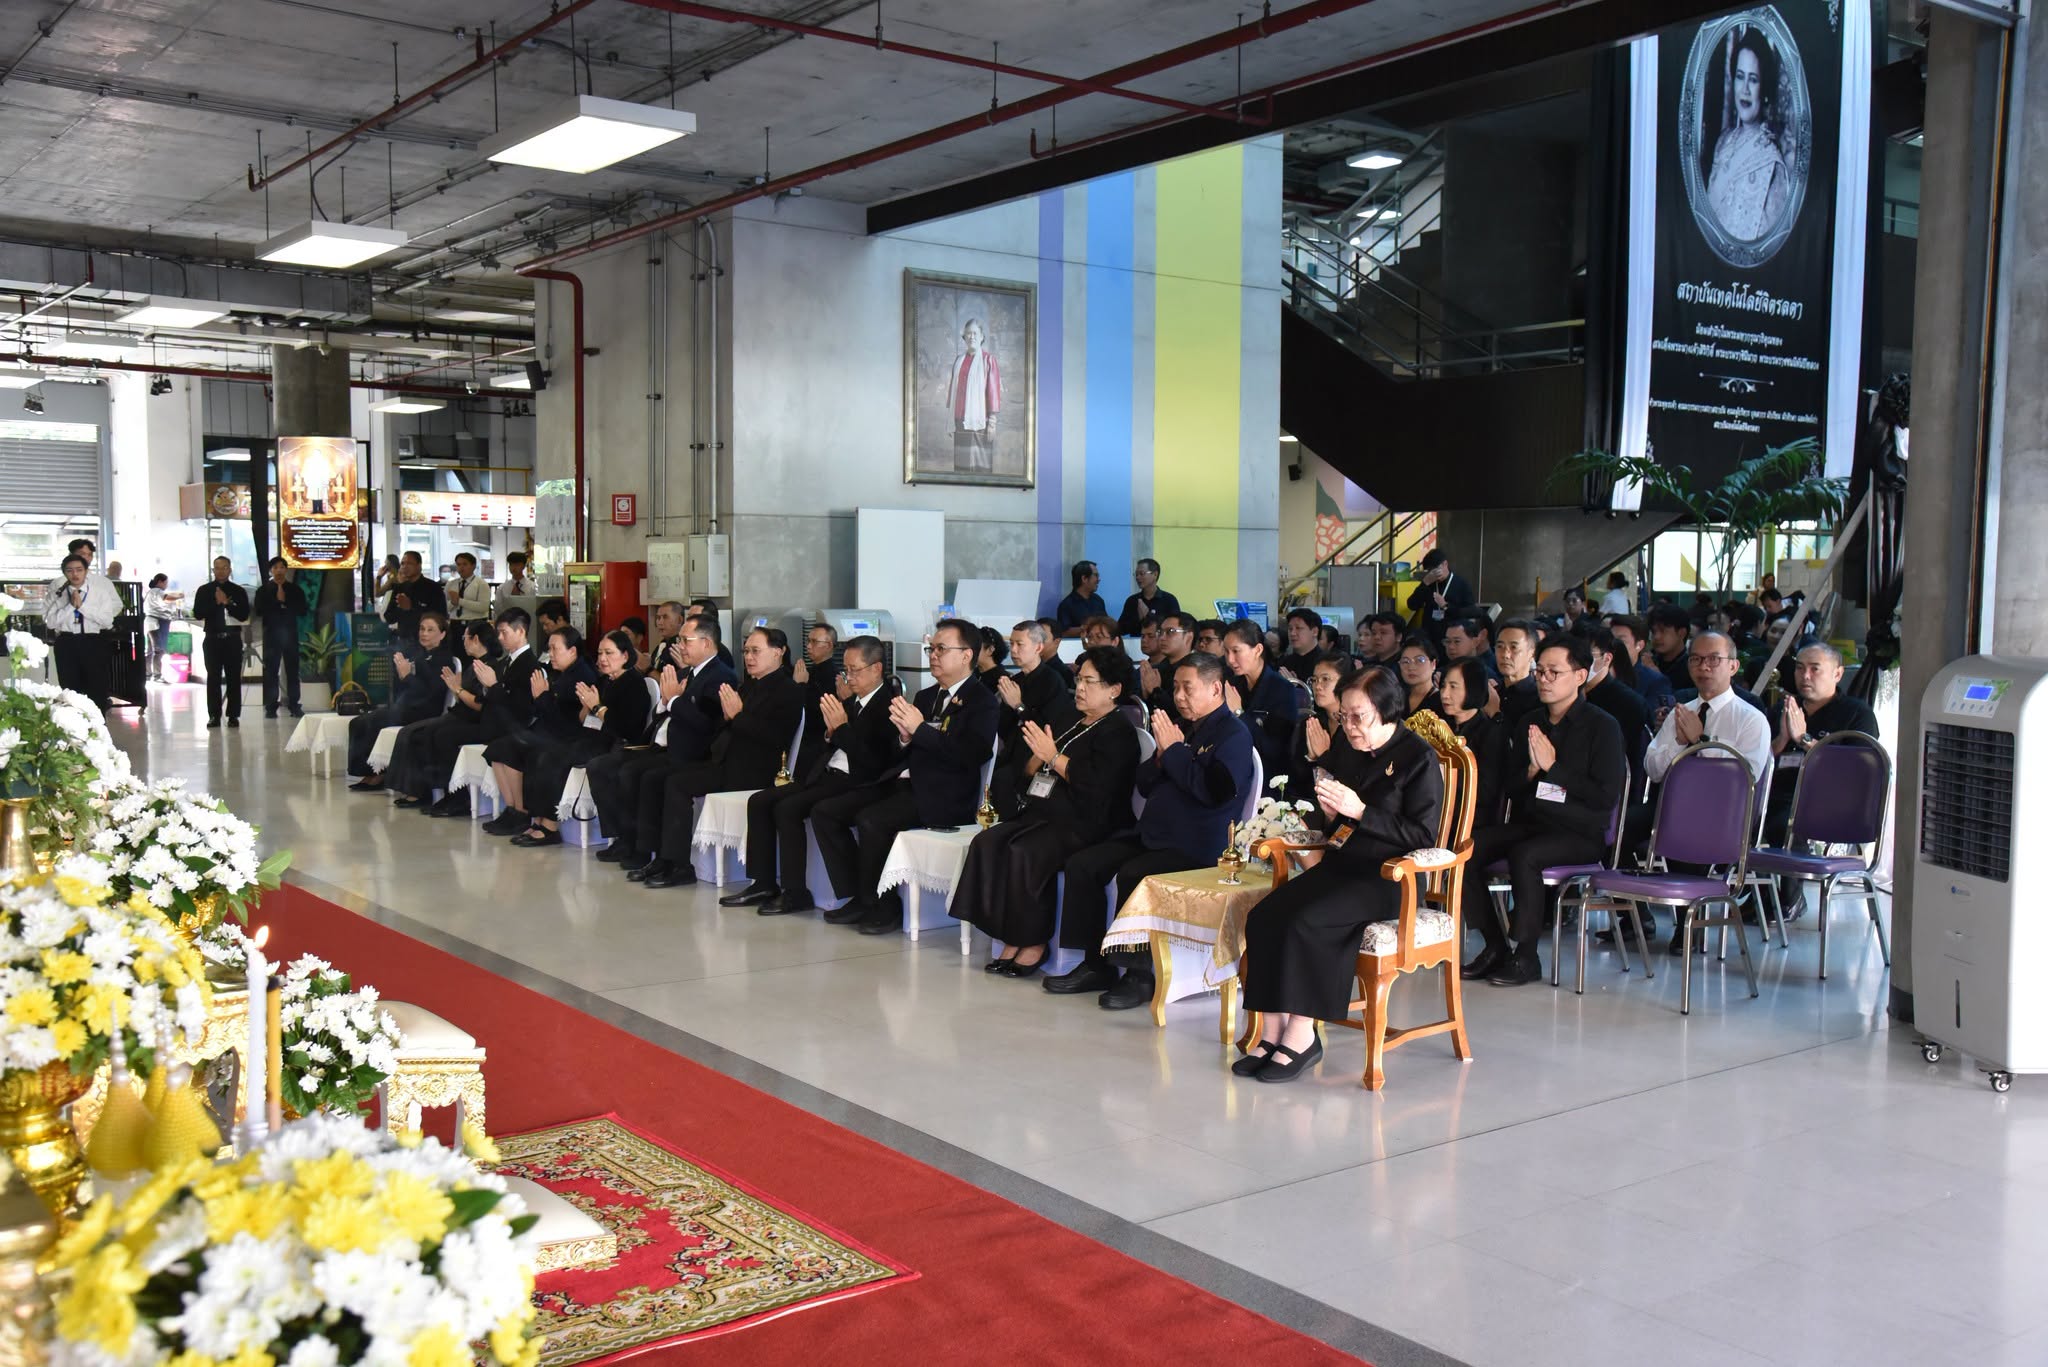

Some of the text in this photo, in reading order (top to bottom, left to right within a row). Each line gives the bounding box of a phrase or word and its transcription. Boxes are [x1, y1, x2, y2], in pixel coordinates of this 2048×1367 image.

[1676, 280, 1804, 320] สถาบันเทคโนโลยีจิตรลดา
